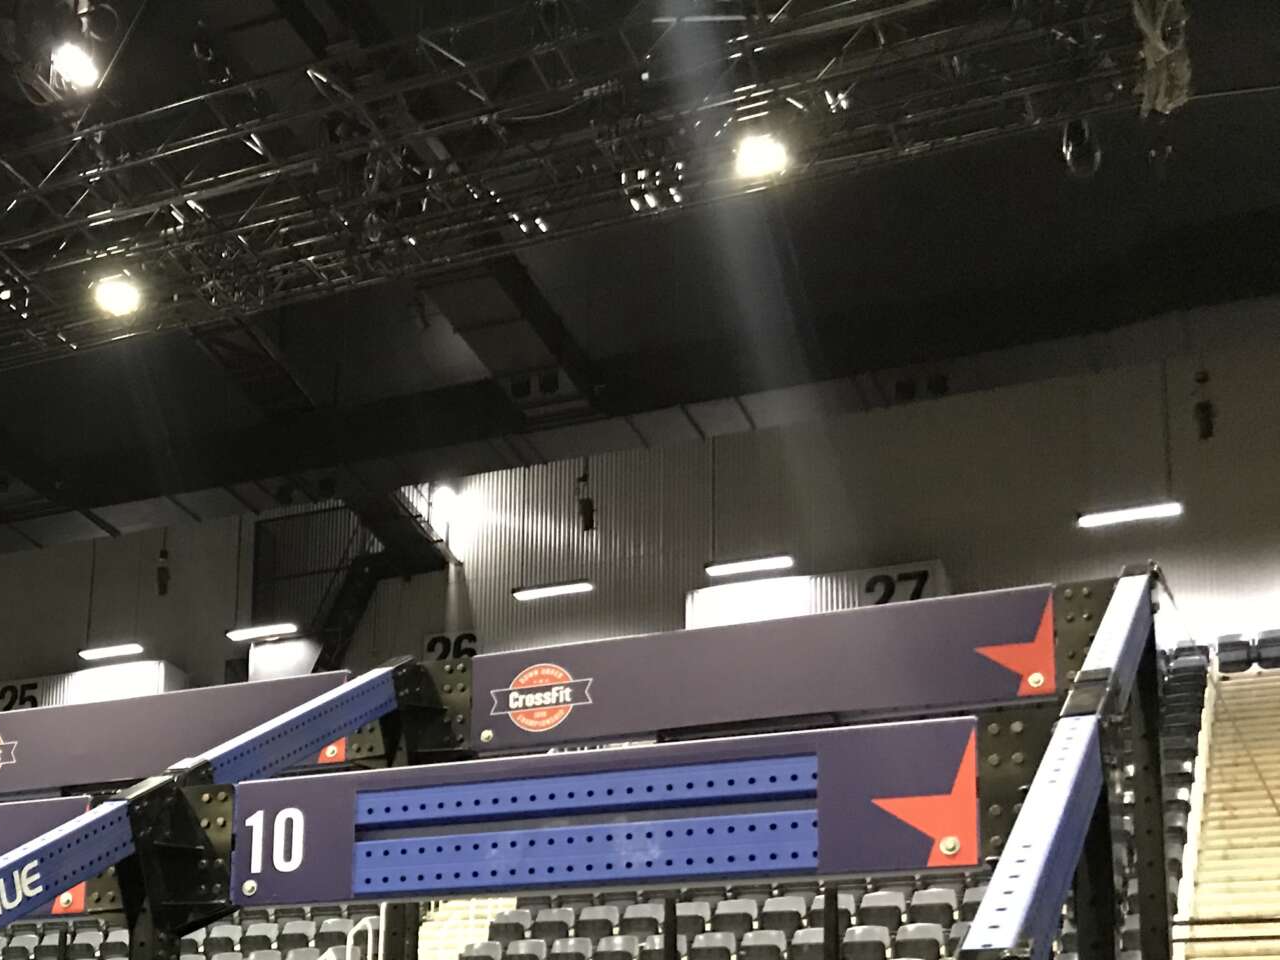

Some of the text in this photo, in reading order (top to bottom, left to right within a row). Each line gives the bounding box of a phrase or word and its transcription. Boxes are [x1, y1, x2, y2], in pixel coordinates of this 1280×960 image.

[865, 570, 929, 605] 27
[0, 683, 38, 711] 25
[509, 685, 572, 709] CrossFit
[244, 807, 305, 874] 10
